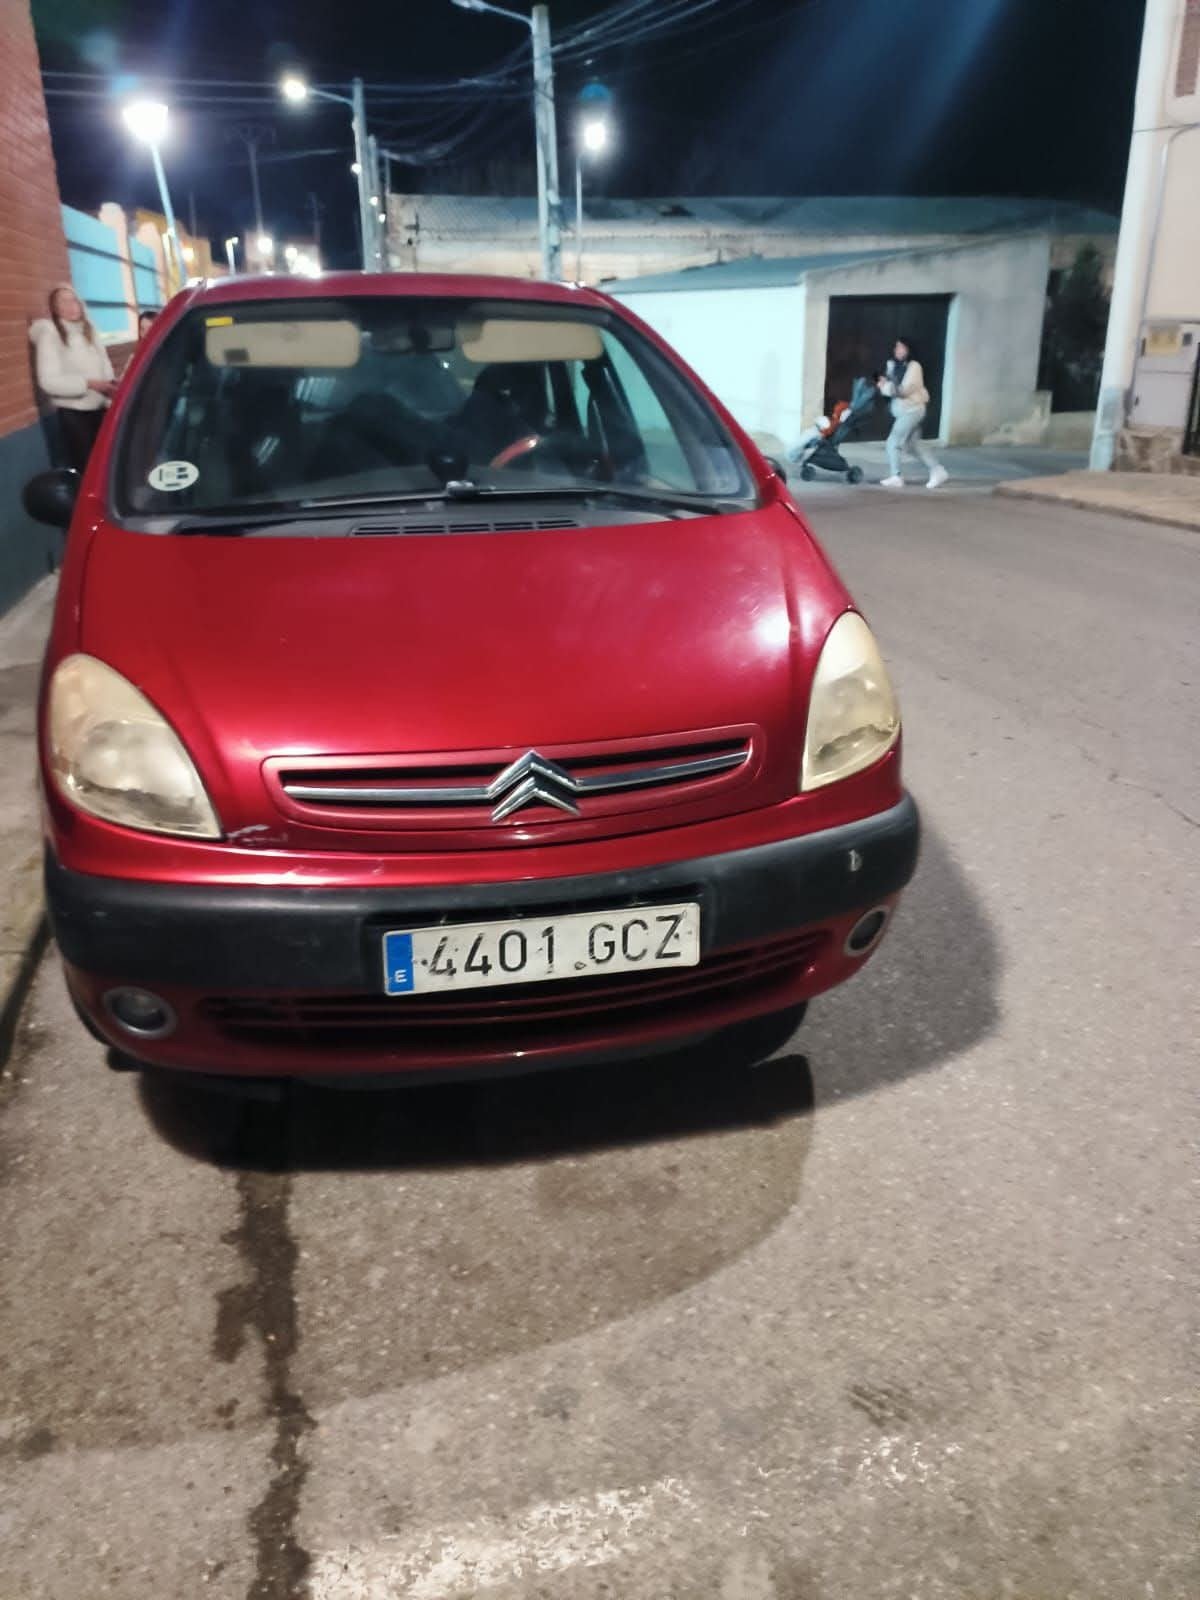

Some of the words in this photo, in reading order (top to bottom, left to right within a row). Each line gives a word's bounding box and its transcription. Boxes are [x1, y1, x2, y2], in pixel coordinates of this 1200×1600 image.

[429, 926, 555, 977] 4401
[588, 913, 685, 965] GCZ
[394, 969, 407, 983] E
